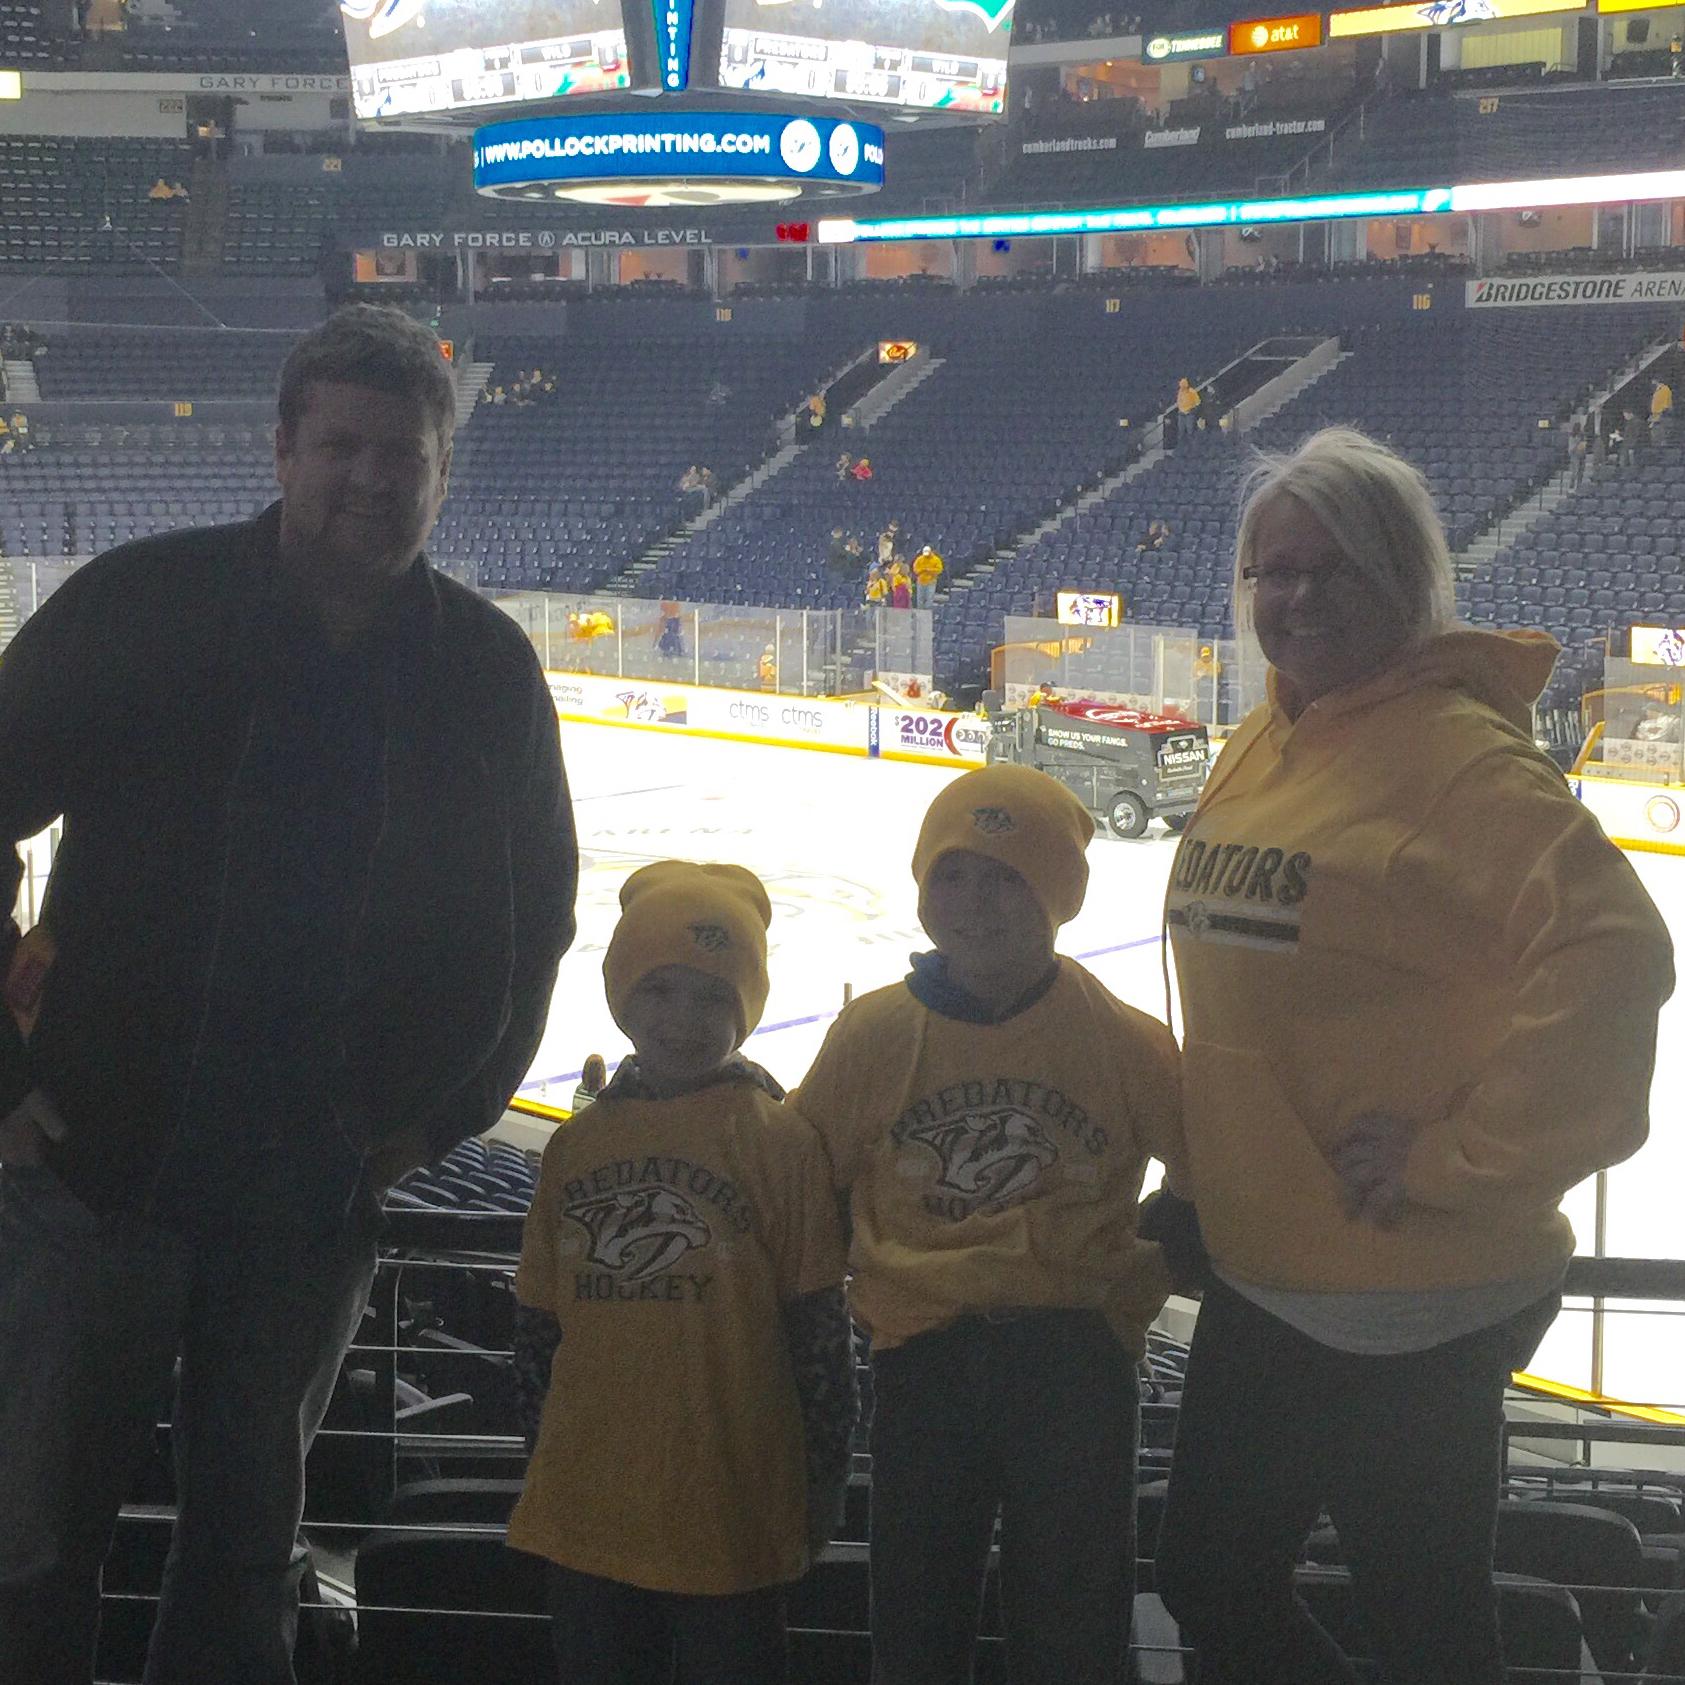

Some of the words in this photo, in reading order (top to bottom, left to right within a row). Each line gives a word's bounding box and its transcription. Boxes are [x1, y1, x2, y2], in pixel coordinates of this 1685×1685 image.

[1270, 24, 1300, 43] at&t
[199, 76, 260, 89] GARY
[1225, 119, 1326, 140] cumberland-tractor.com
[485, 132, 771, 165] WWW.POLLOCKPRINTING.COM
[383, 233, 444, 247] GARY
[454, 232, 532, 246] FORCE
[562, 230, 636, 246] ACURA
[643, 229, 713, 244] LEVEL
[1475, 278, 1627, 303] BRIDGESTONE
[729, 700, 770, 722] ctms
[781, 706, 823, 728] ctms
[900, 734, 944, 748] MILLION
[1047, 737, 1059, 746] GO
[1048, 728, 1070, 738] SHOW
[1070, 731, 1081, 741] US
[1081, 733, 1101, 743] YOUR
[1163, 749, 1206, 766] NISSAN
[575, 1273, 714, 1301] HOCKEY
